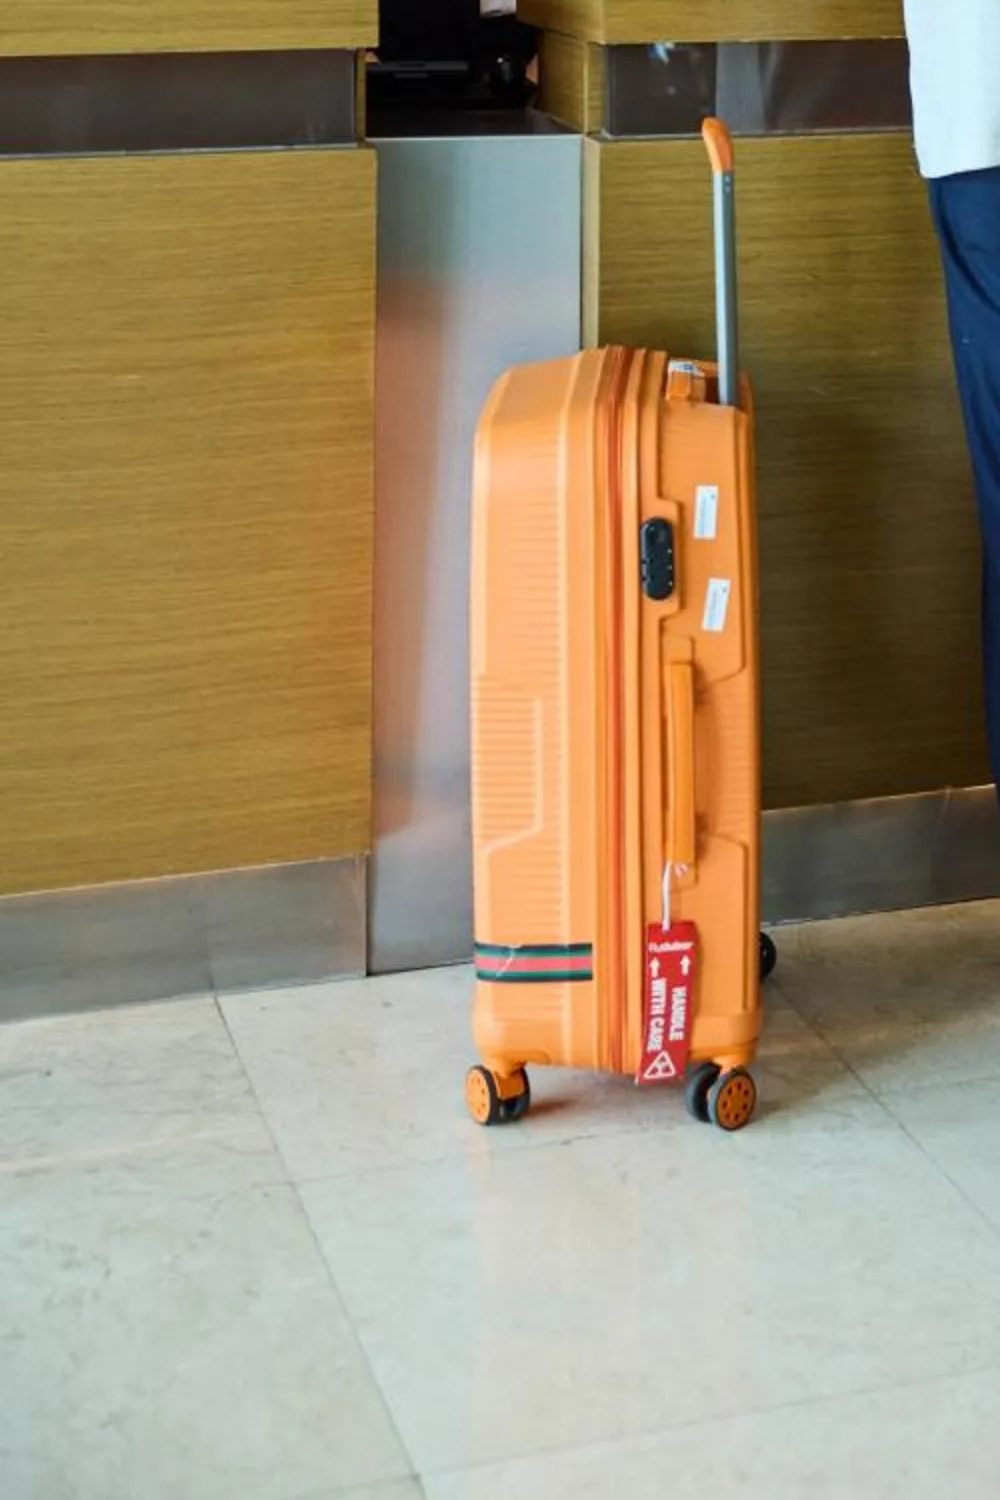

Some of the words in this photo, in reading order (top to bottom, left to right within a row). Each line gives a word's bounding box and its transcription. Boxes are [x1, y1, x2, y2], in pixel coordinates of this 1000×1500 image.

[651, 978, 666, 1015] WITH
[669, 986, 687, 1040] HANDLE
[647, 1017, 664, 1053] CARE
